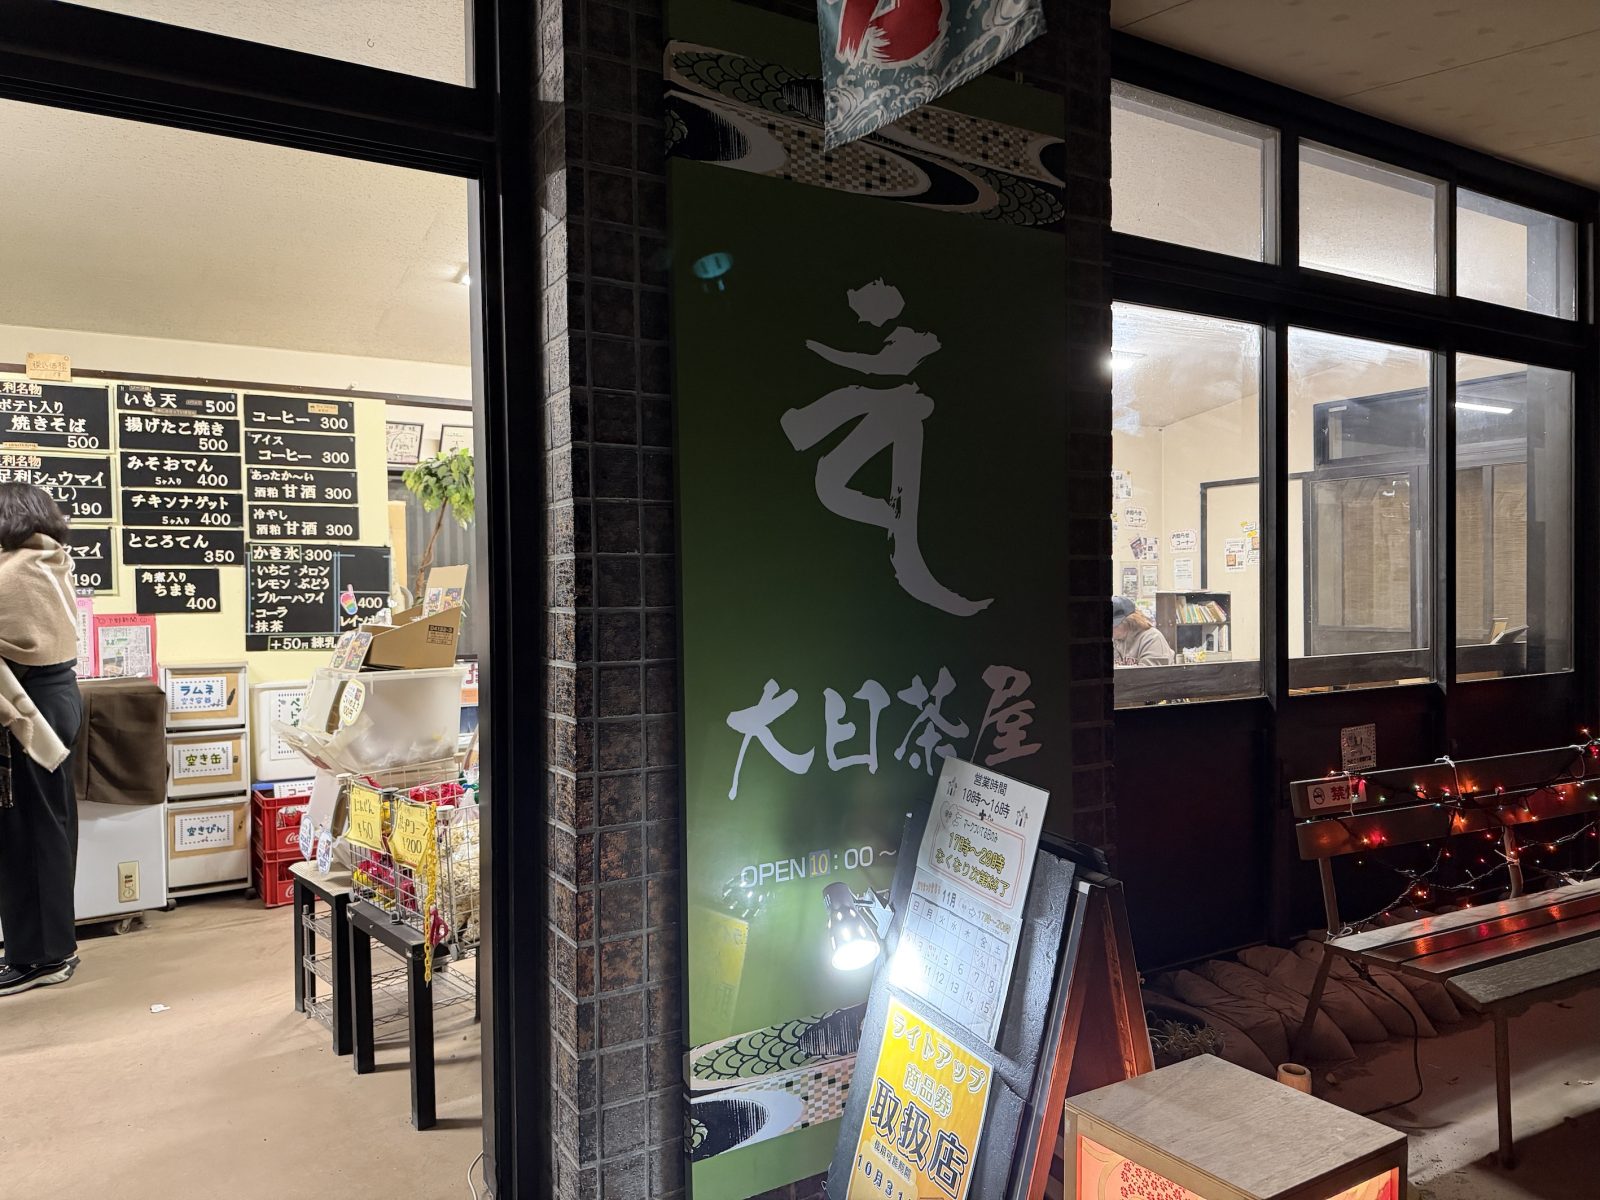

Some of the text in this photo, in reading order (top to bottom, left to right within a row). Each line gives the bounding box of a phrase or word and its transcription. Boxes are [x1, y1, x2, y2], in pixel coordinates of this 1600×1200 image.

[0, 382, 41, 395] 利名物
[0, 399, 63, 414] ポテト入り
[124, 392, 177, 408] いも天
[205, 400, 235, 413] 500
[11, 415, 86, 432] 焼きそば
[125, 417, 224, 436] 揚げたこ焼き
[252, 410, 348, 430] コーヒー 300
[67, 436, 99, 449] 500
[199, 438, 228, 451] 500
[251, 434, 284, 445] アイス
[258, 448, 349, 464] コーヒー 300
[127, 456, 213, 472] みそおでん
[197, 474, 228, 487] 400
[282, 484, 317, 499] 甘酒
[324, 488, 352, 500] 300
[72, 502, 102, 515] 190
[131, 494, 229, 509] チキンナゲット
[200, 513, 231, 525] 400
[253, 508, 288, 520] 冷やし
[284, 521, 318, 536] 甘酒
[325, 524, 353, 536] 300
[129, 533, 209, 549] ところてん
[204, 550, 234, 562] 350
[253, 546, 333, 561] かき氷 300
[142, 572, 186, 583] 角煮入り
[257, 565, 330, 576] いちご メロン
[73, 573, 101, 586] 190
[257, 578, 330, 590] レモン ぶどう
[154, 583, 196, 597] ちまき
[257, 591, 325, 604] ブルーハワイ
[186, 597, 217, 610] 400
[358, 596, 383, 609] 400
[255, 606, 288, 618] コーラ
[254, 620, 284, 633] 抹茶
[310, 636, 337, 649] 練乳
[180, 684, 214, 696] ラムネ
[726, 665, 1042, 800] 大日茶屋
[186, 753, 222, 767] 空き缶
[974, 772, 1008, 797] 営業時間
[962, 788, 1011, 819] 10時〜16時
[187, 824, 226, 837] 空きびん
[949, 832, 1006, 874] 17時〜20時
[740, 859, 806, 888] OPEN
[935, 848, 1010, 898] なくなり次第終了
[942, 889, 957, 909] 11月
[912, 901, 920, 912] 日
[927, 907, 933, 919] 月
[950, 919, 958, 932] 水
[980, 935, 989, 949] 金
[943, 954, 949, 966] 5
[957, 963, 964, 975] 6
[974, 972, 981, 984] 7
[987, 980, 995, 994] 8
[935, 971, 945, 985] 12
[950, 980, 960, 994] 13
[965, 991, 974, 1004] 14
[980, 1001, 990, 1014] 15
[893, 1013, 987, 1094] ライトアップ
[903, 1063, 953, 1118] 商品券
[870, 1078, 969, 1199] 取扱店
